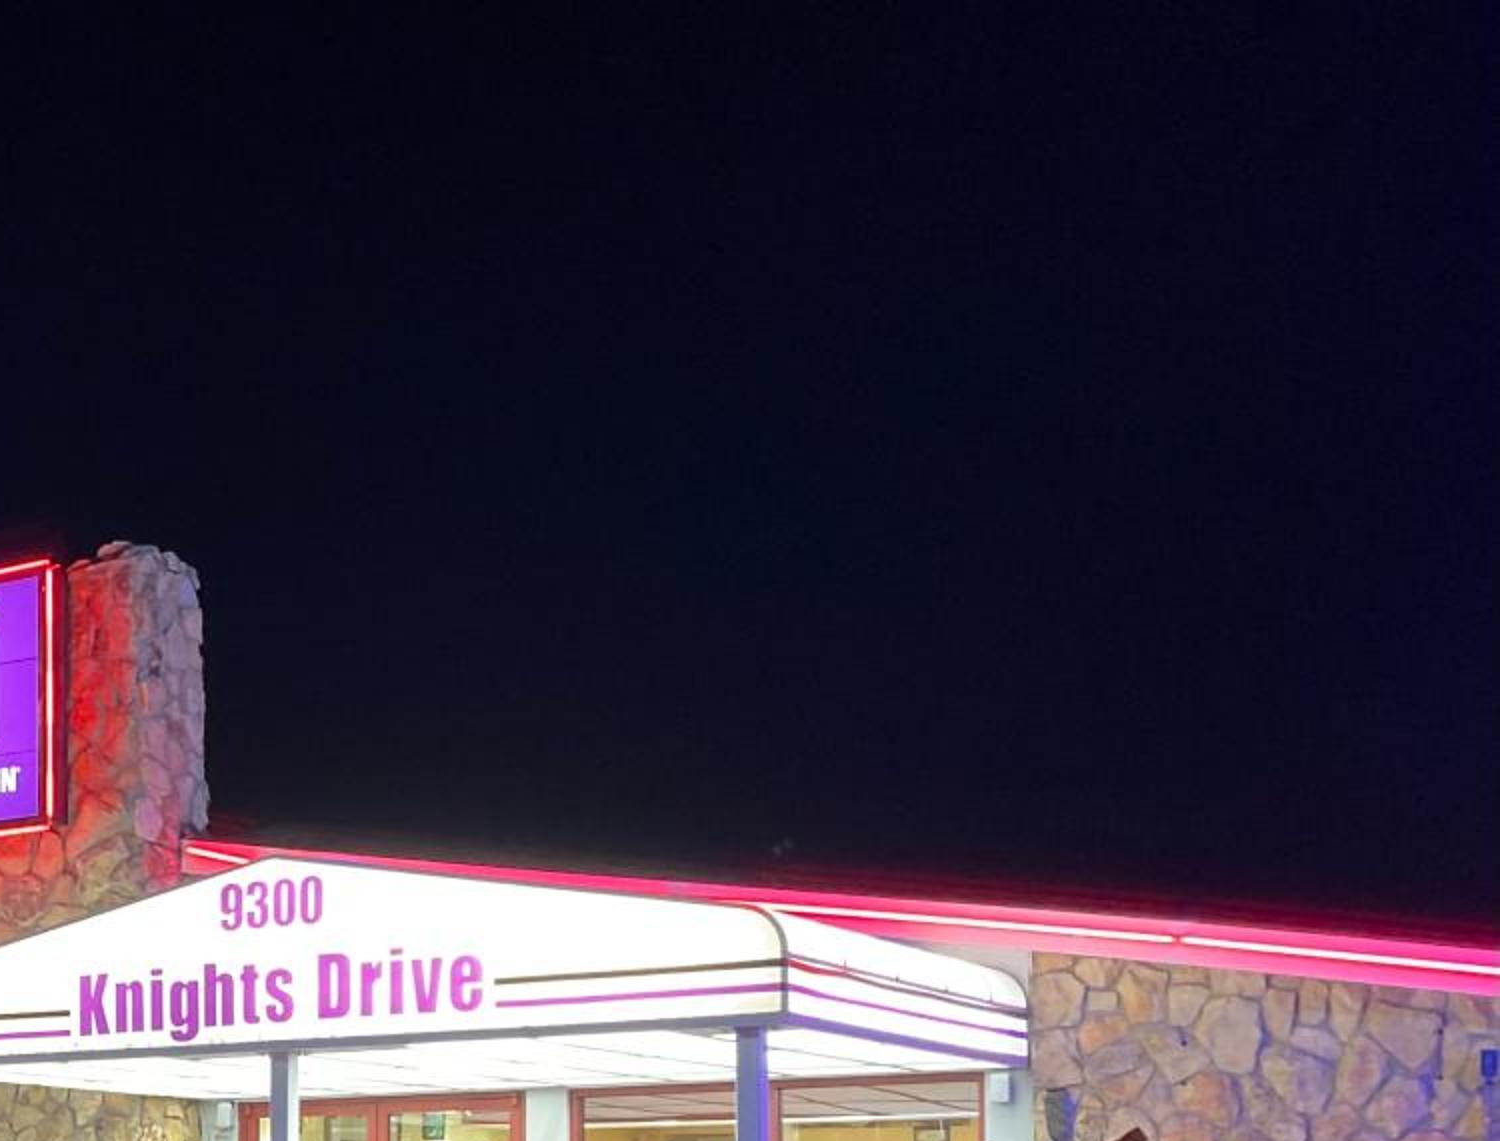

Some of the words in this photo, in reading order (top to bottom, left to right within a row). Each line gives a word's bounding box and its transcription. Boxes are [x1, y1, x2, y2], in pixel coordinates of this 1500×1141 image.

[220, 875, 323, 931] 9300
[79, 963, 296, 1043] Knights
[317, 947, 484, 1020] Drive
